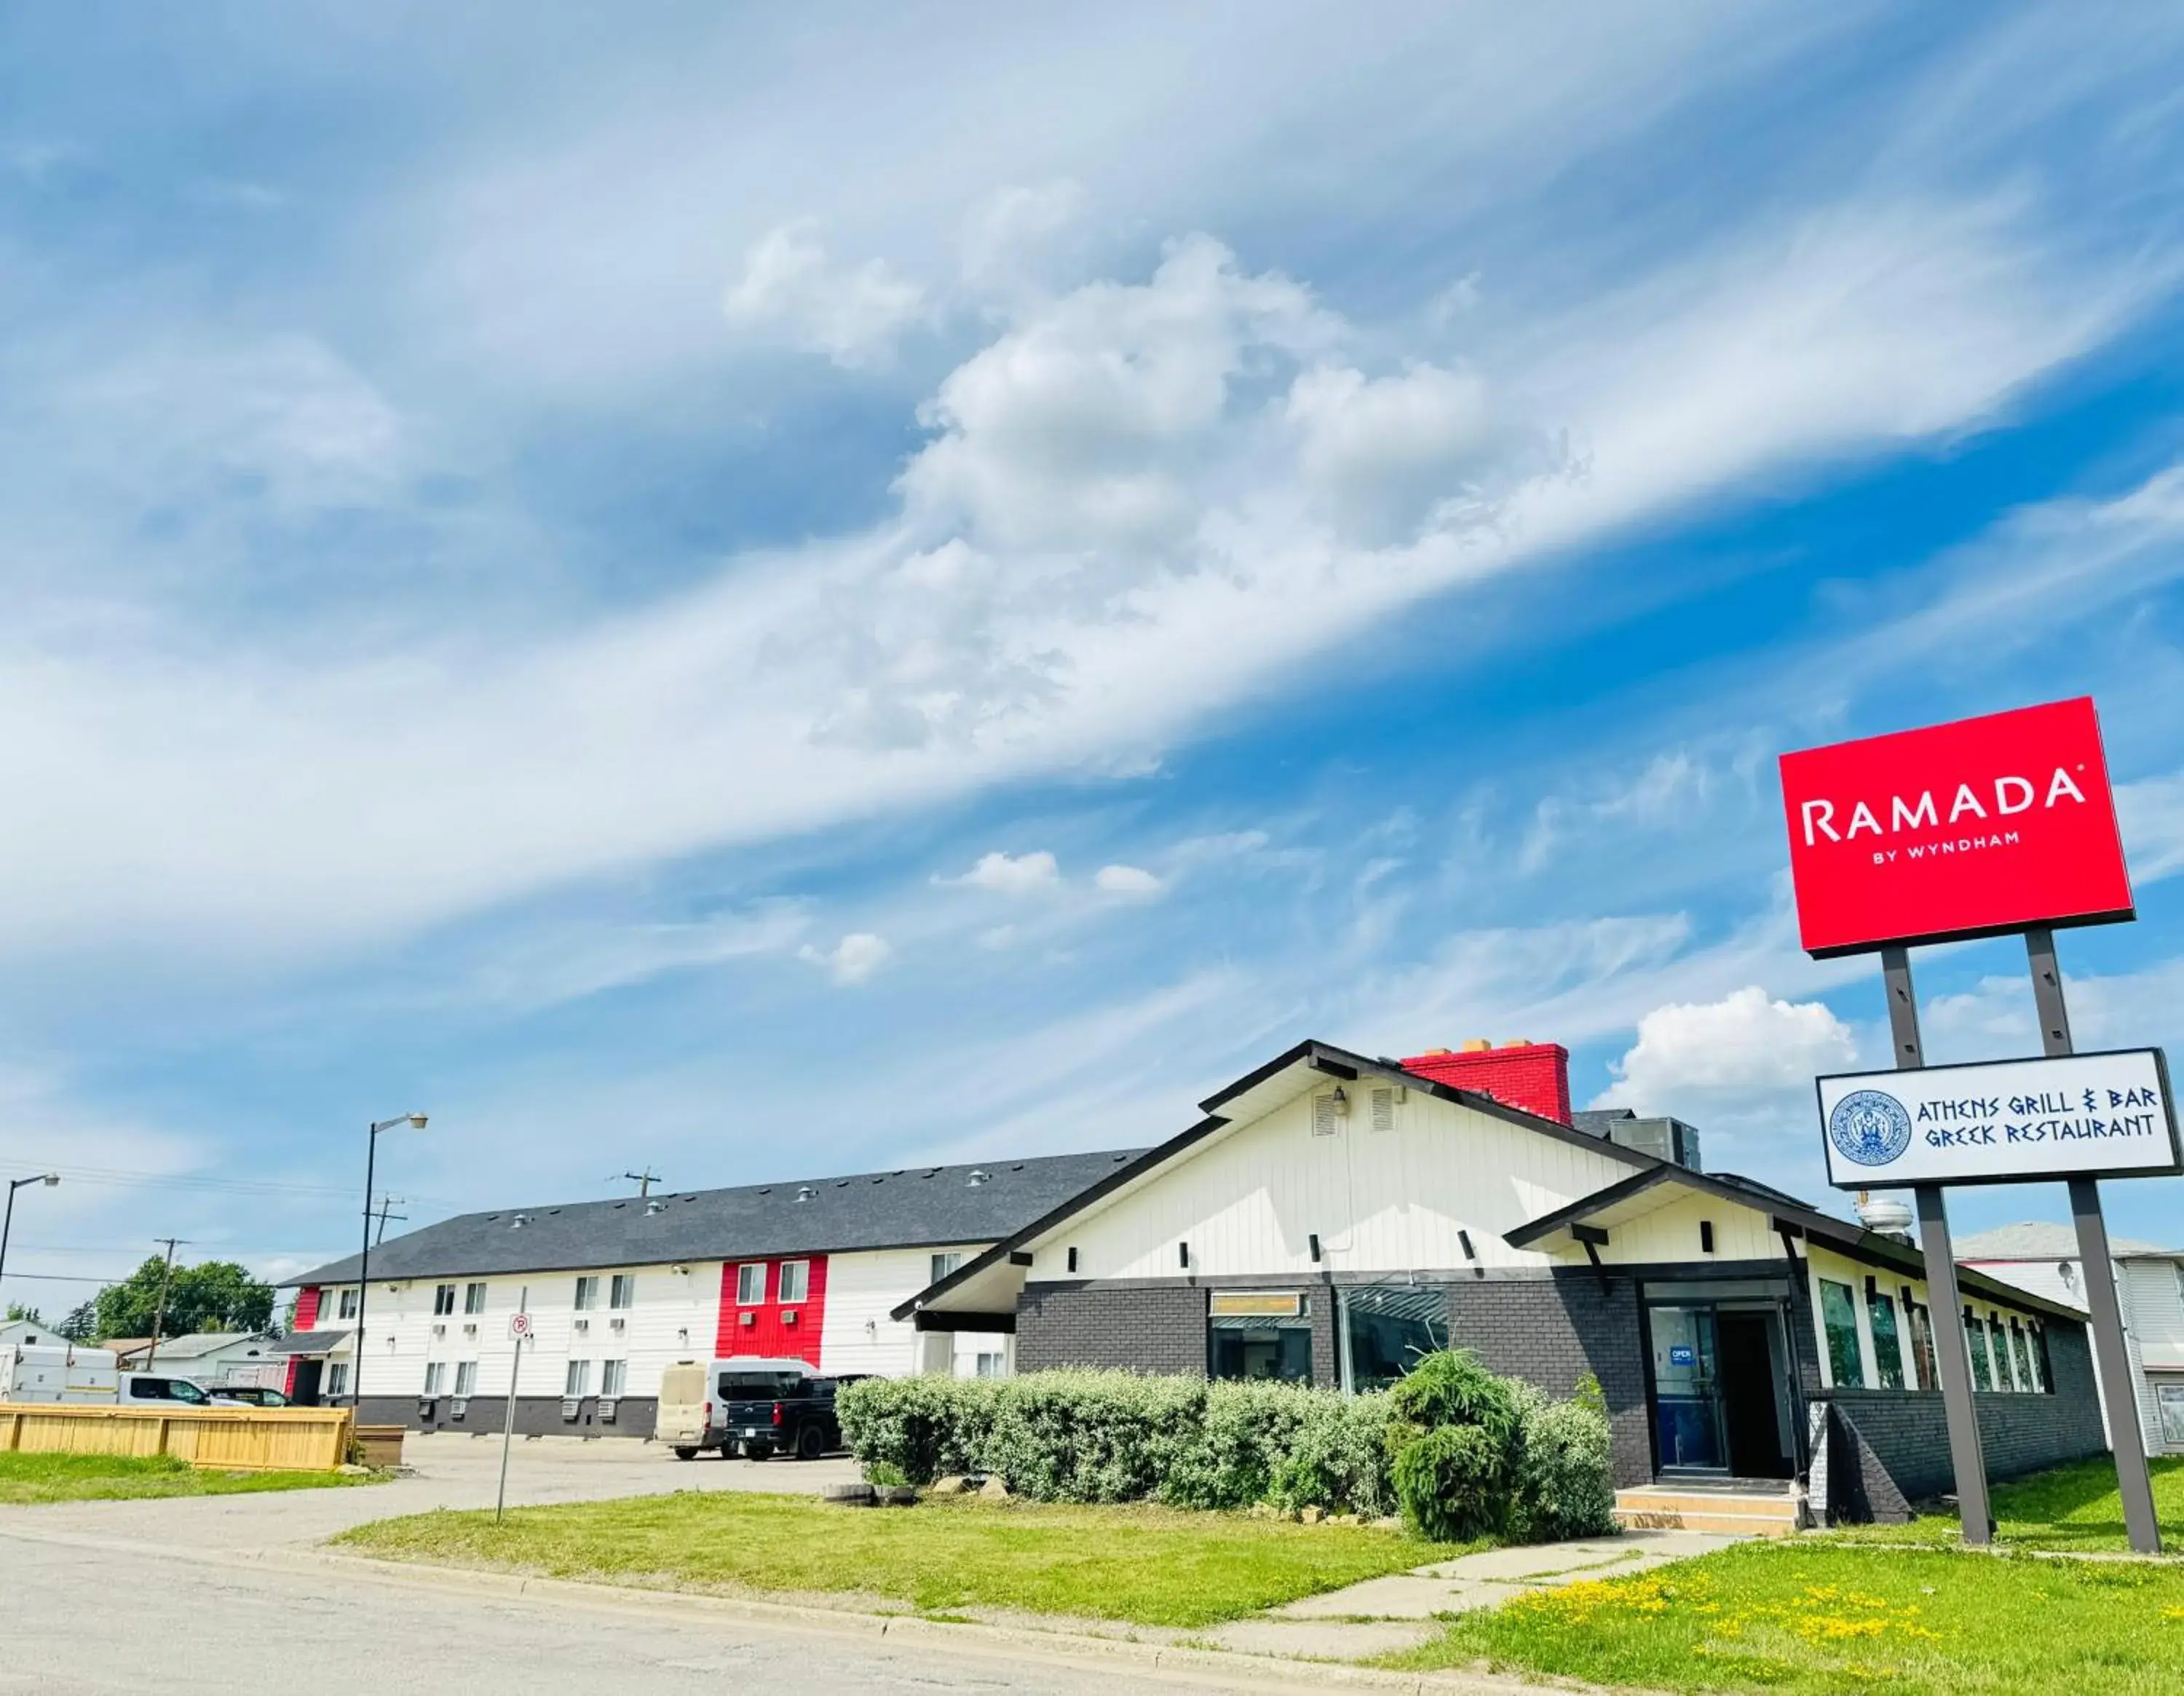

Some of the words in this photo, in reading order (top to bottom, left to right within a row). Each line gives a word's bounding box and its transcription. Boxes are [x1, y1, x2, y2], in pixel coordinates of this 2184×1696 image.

[1800, 766, 2086, 847] RAMADA
[1872, 849, 1897, 865] BY
[1907, 831, 2020, 859] WYNDHAM
[1916, 1096, 2000, 1122] ATHENS
[2007, 1091, 2075, 1116] GRILL
[2082, 1087, 2097, 1112] &
[2105, 1086, 2158, 1109] BAR
[1924, 1125, 1997, 1148] GREEK
[2003, 1114, 2156, 1144] RESTAURANT
[1672, 1350, 1691, 1358] OPEN
